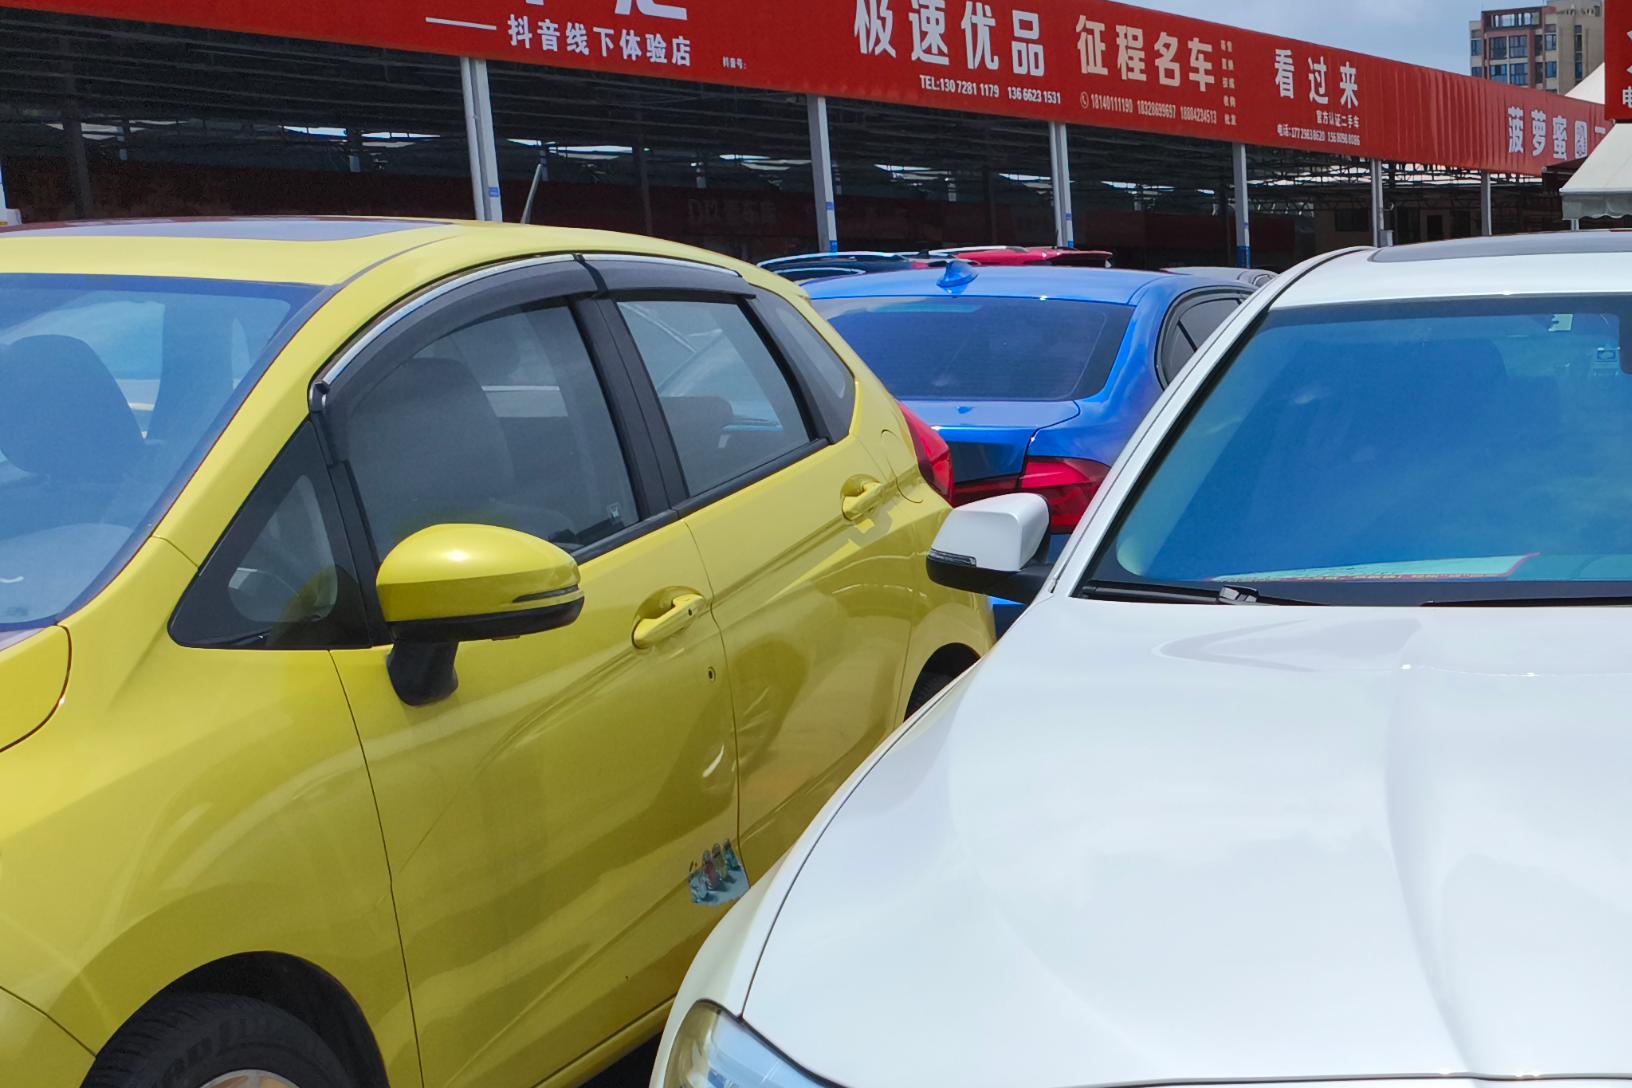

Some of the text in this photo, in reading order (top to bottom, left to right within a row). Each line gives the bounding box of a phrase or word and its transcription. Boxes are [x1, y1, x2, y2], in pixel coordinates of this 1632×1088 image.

[507, 14, 691, 66] 抖音线下体验店
[854, 0, 1045, 77] 极速优品
[1075, 14, 1215, 92] 征程名车
[957, 80, 977, 95] 7281
[980, 83, 1000, 97] 1179
[1274, 48, 1359, 109] 看过来
